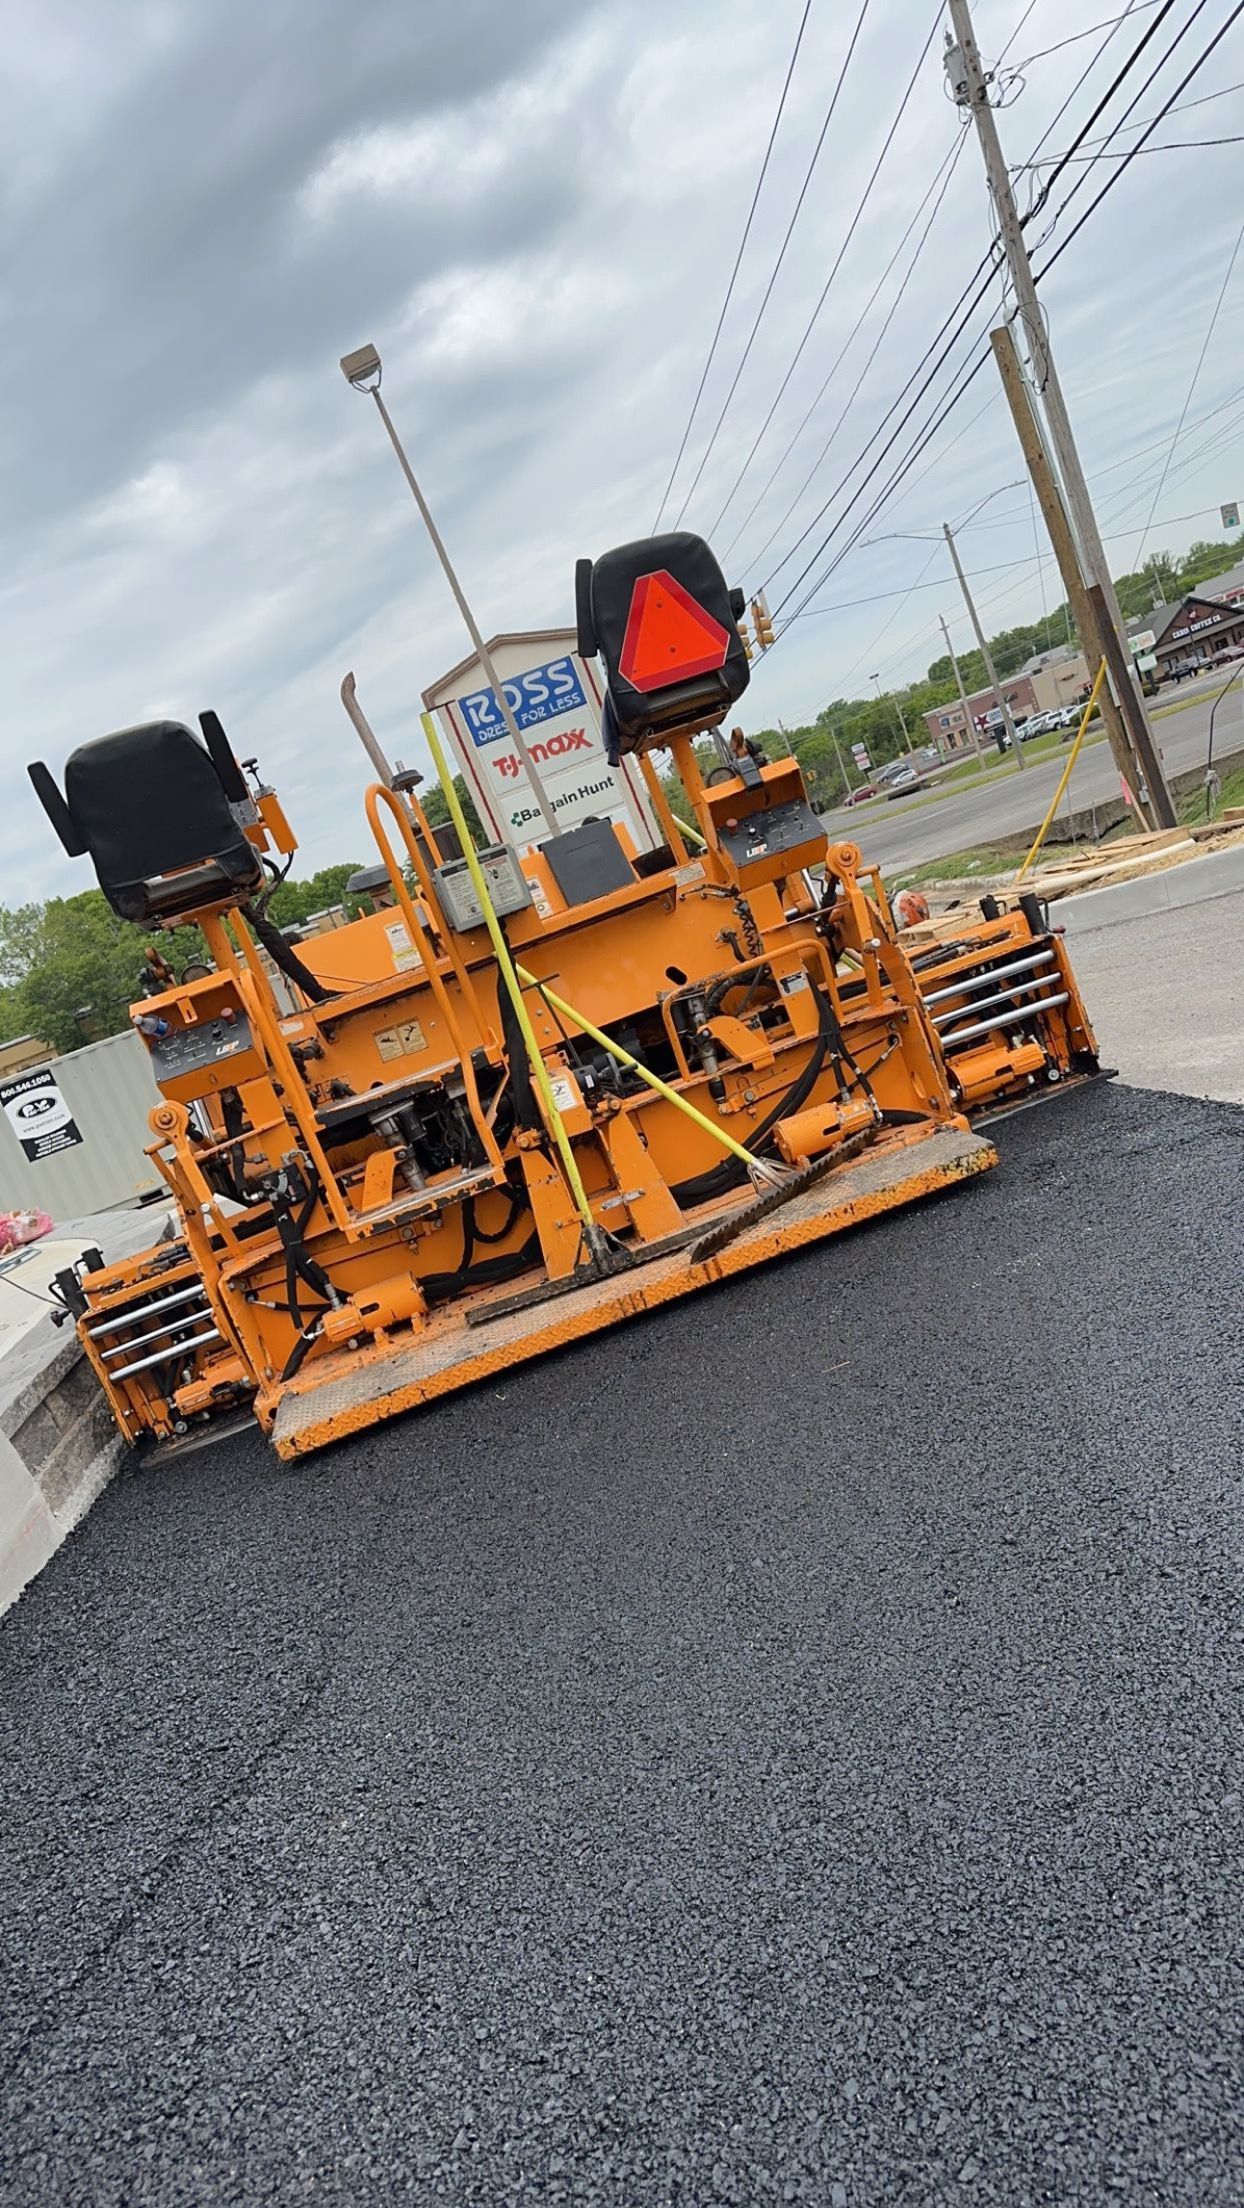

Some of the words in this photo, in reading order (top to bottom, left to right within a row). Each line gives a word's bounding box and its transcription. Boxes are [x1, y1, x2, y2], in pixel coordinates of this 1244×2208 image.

[466, 661, 574, 727] ROSS
[478, 720, 517, 741] DRES
[521, 708, 547, 724] FOR
[550, 692, 581, 713] LESS
[520, 791, 578, 822] Bagain
[577, 775, 615, 799] Hunt
